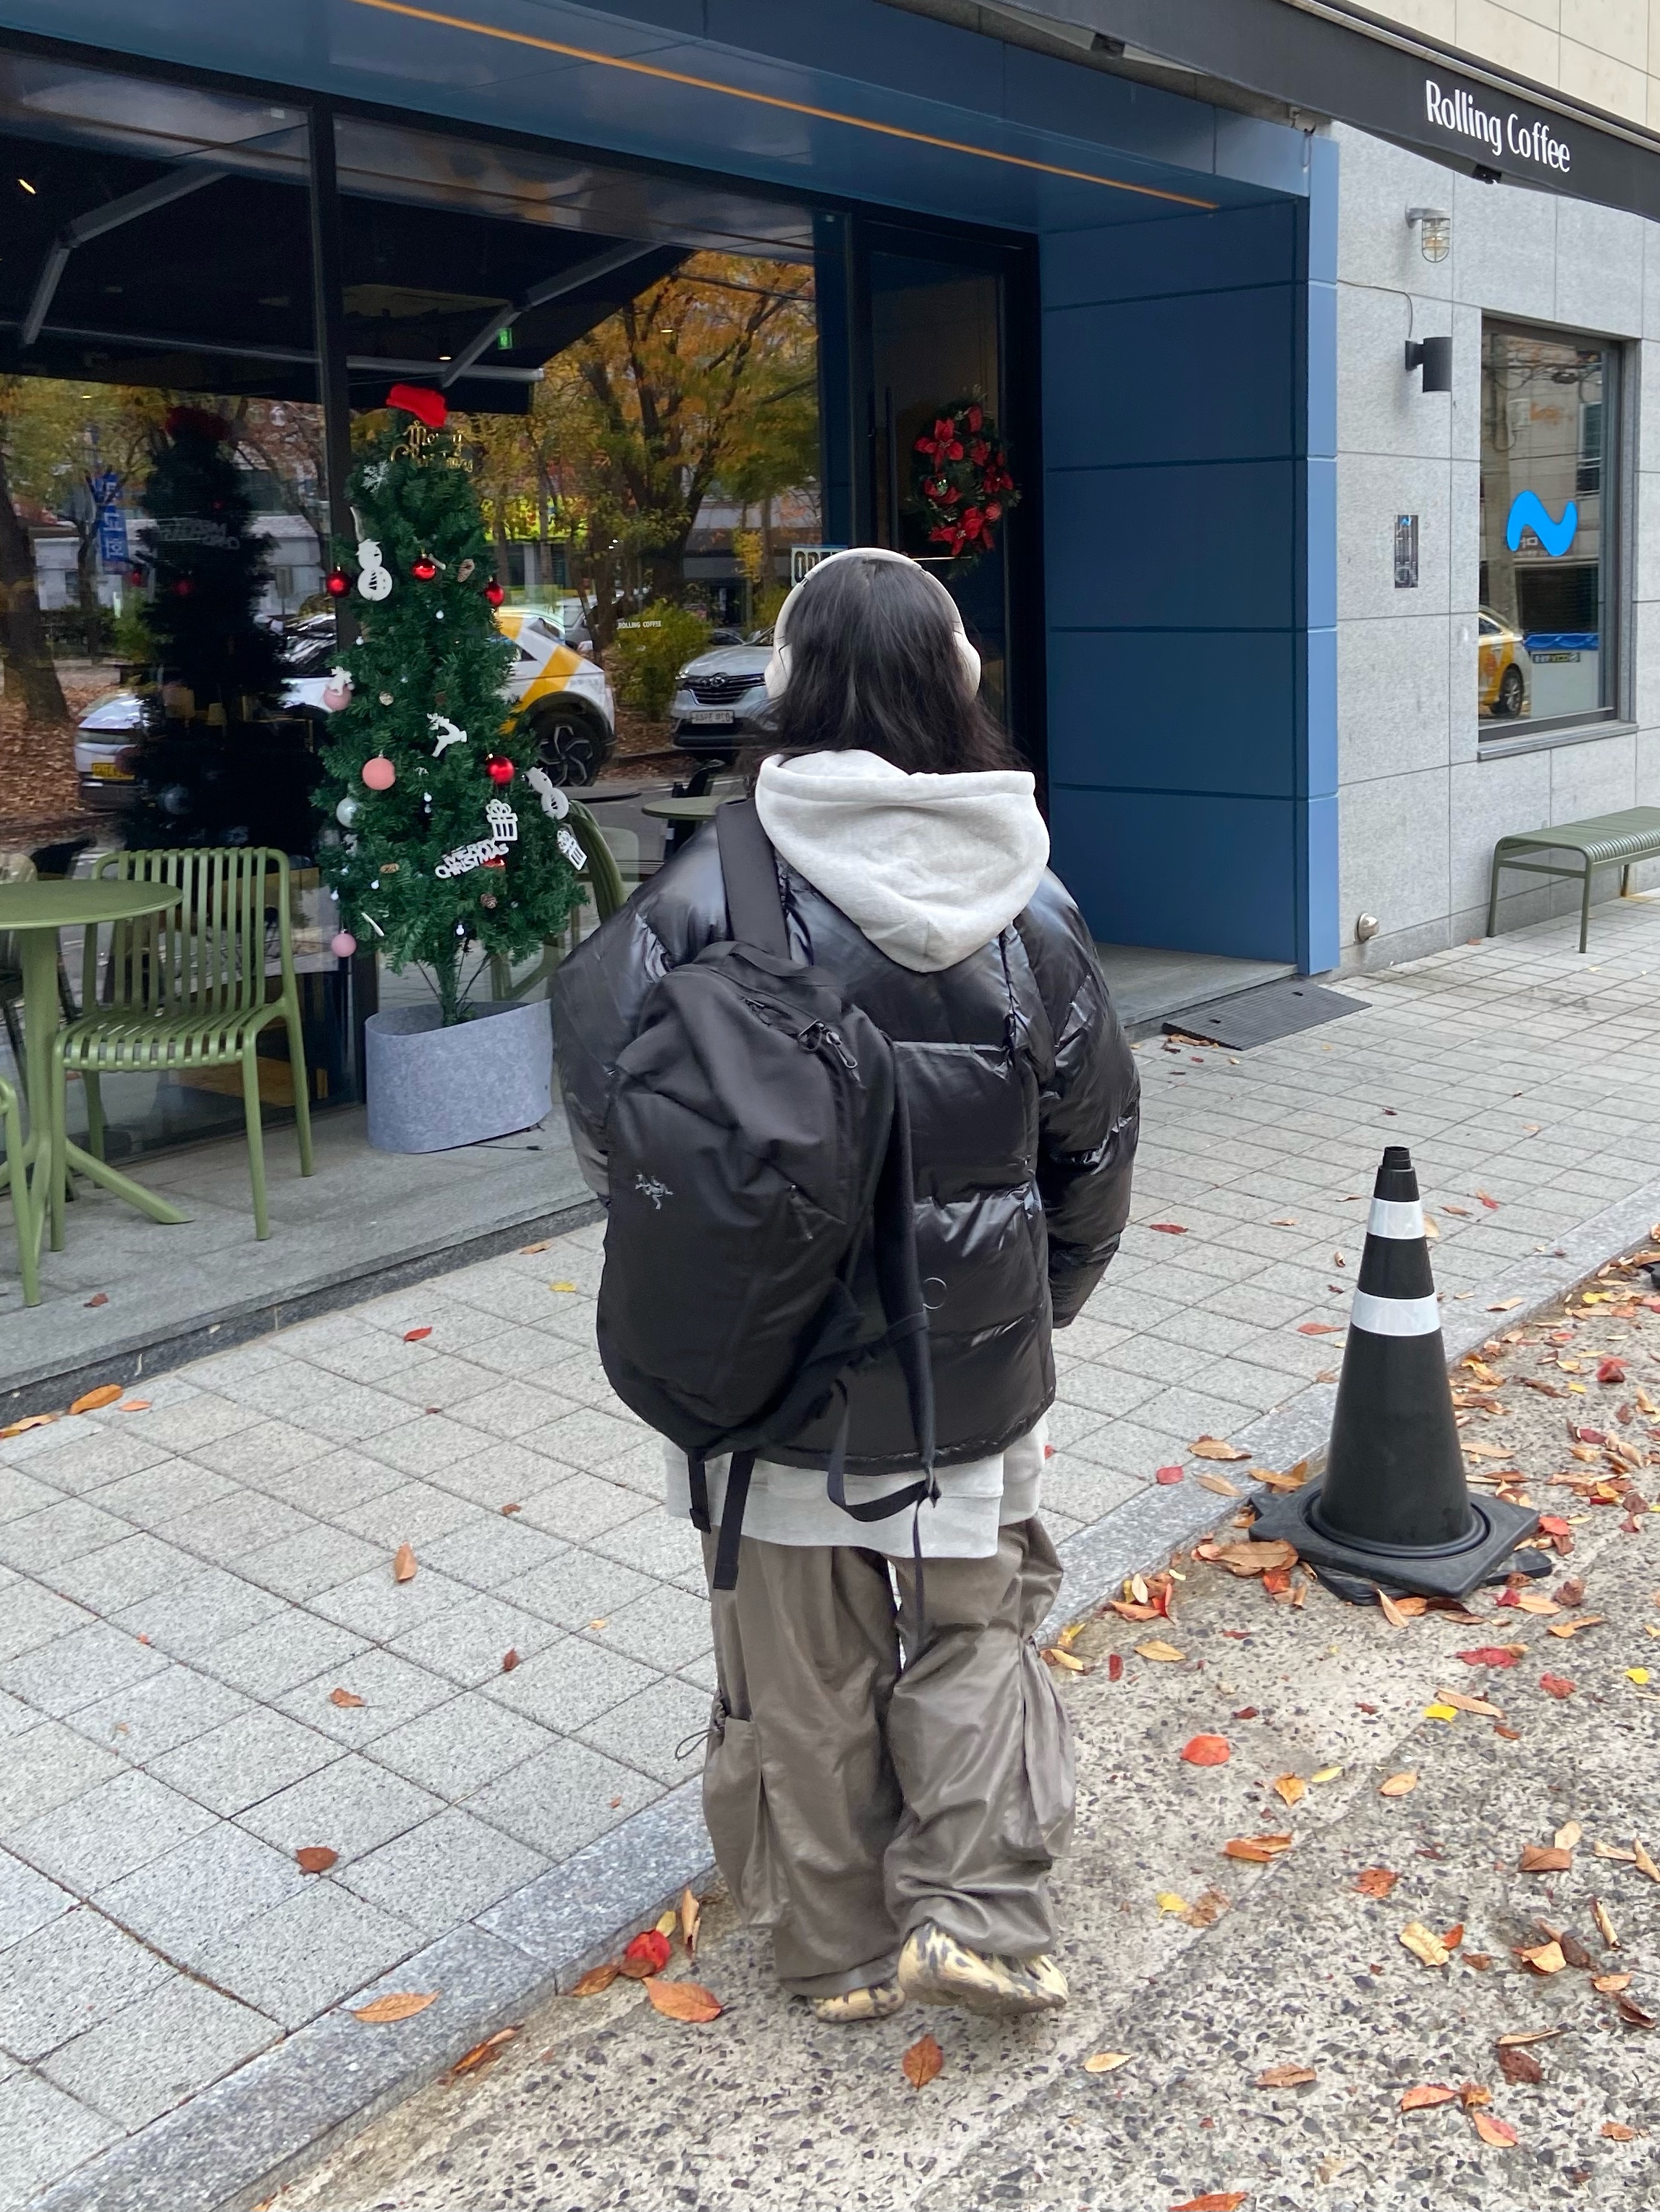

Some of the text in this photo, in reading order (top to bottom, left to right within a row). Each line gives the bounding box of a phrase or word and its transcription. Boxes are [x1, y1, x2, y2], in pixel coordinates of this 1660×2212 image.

[1426, 79, 1571, 173] Rolling Coffee
[617, 621, 641, 630] ROLLING
[435, 843, 509, 879] CHRISTMAS
[443, 837, 496, 868] MERRY
